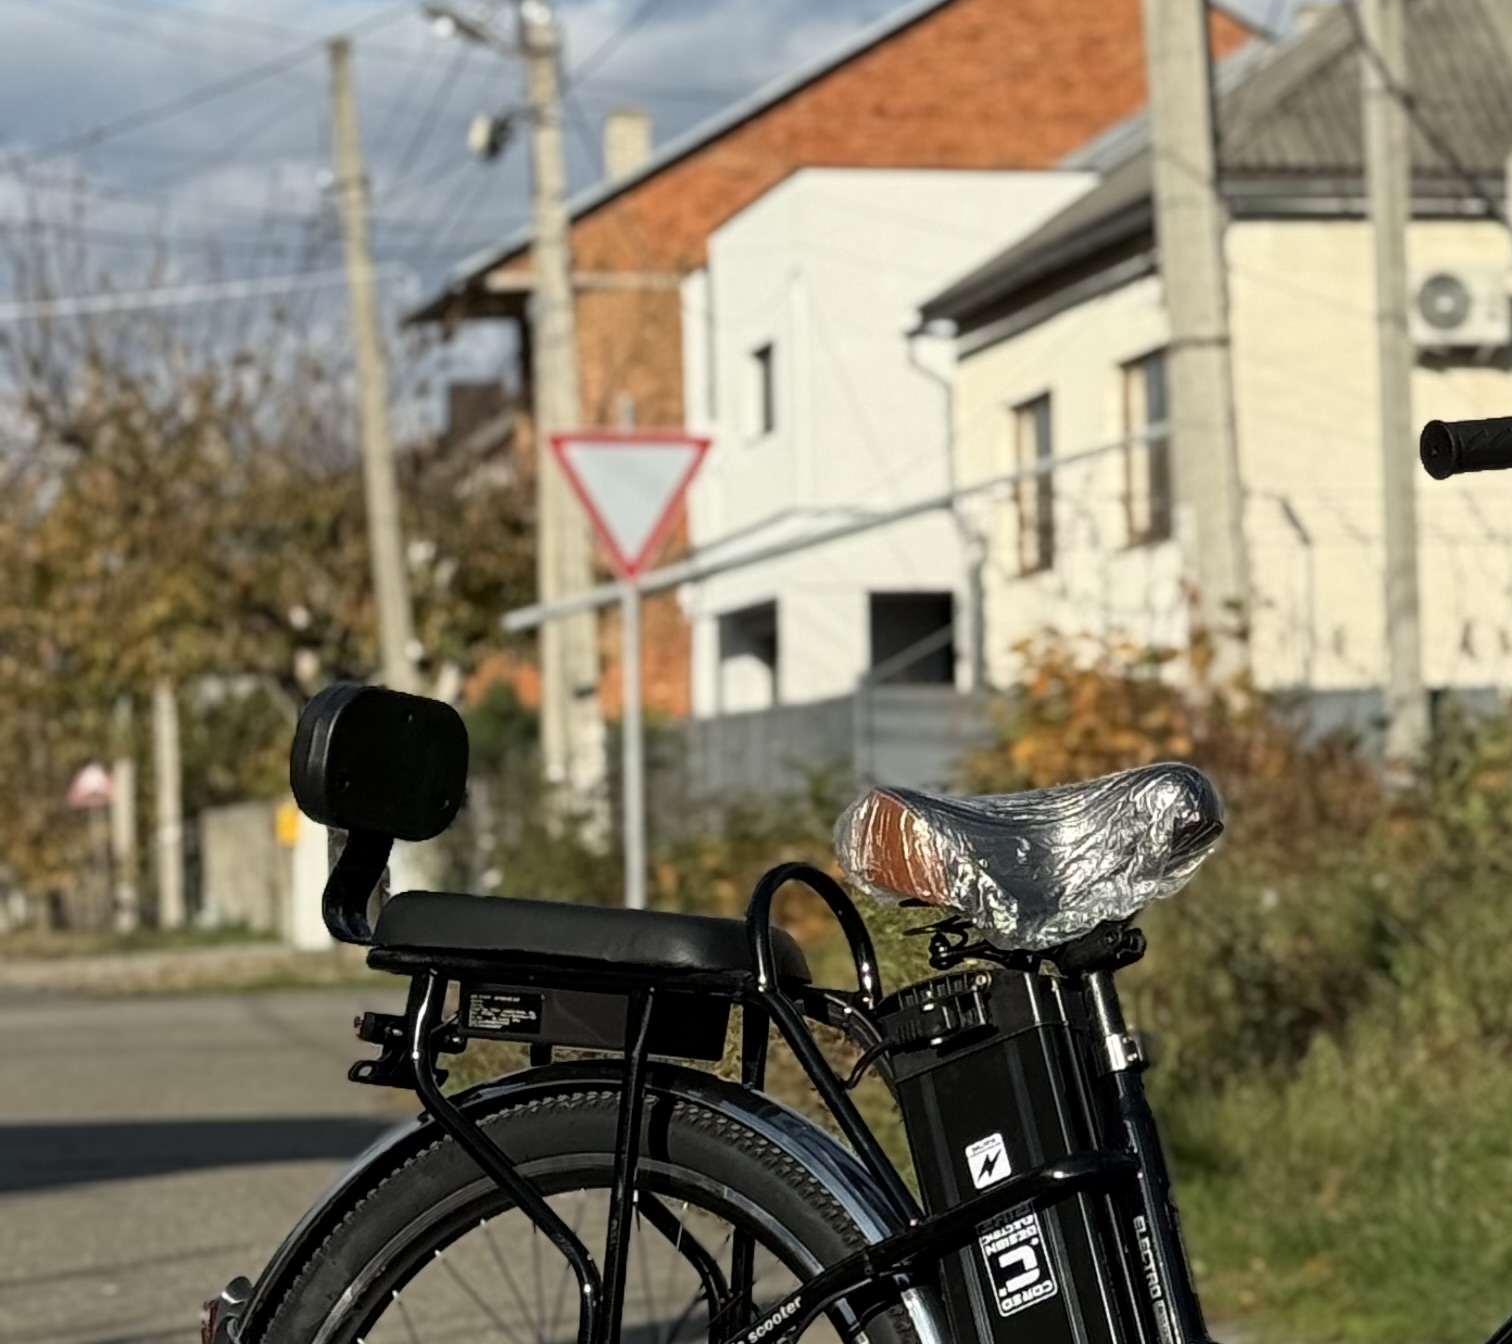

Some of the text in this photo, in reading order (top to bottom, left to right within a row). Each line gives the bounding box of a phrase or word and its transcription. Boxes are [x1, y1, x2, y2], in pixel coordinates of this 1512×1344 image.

[985, 1224, 1038, 1257] DESIGN
[1001, 1279, 1054, 1312] CORSO
[747, 1296, 802, 1344] scooter
